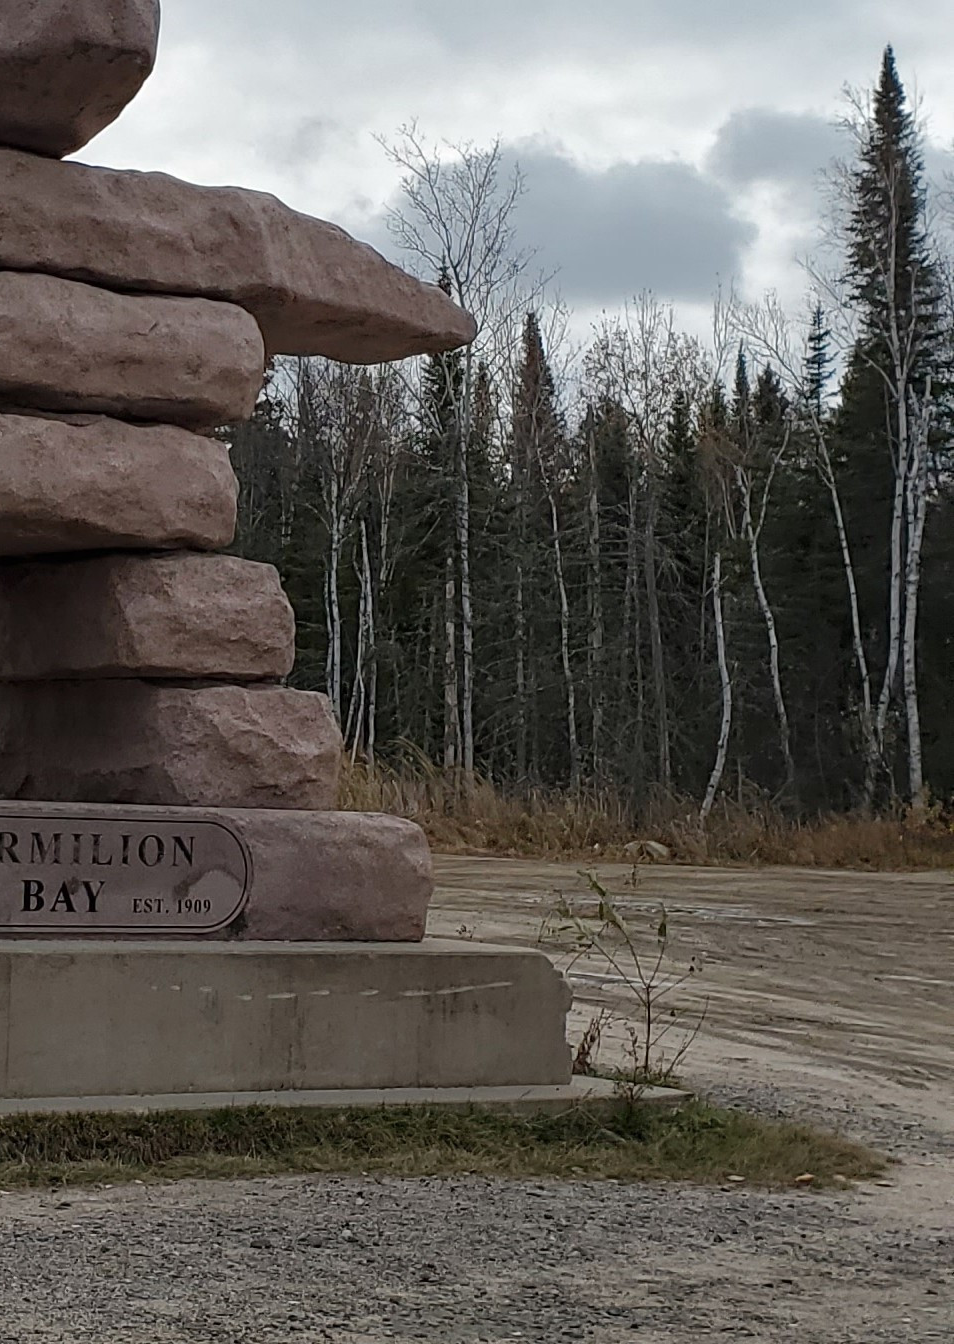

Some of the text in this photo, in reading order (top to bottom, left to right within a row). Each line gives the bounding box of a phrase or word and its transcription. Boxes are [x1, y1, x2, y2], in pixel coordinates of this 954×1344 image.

[20, 879, 106, 913] BAY
[132, 898, 212, 914] EST. 1909
